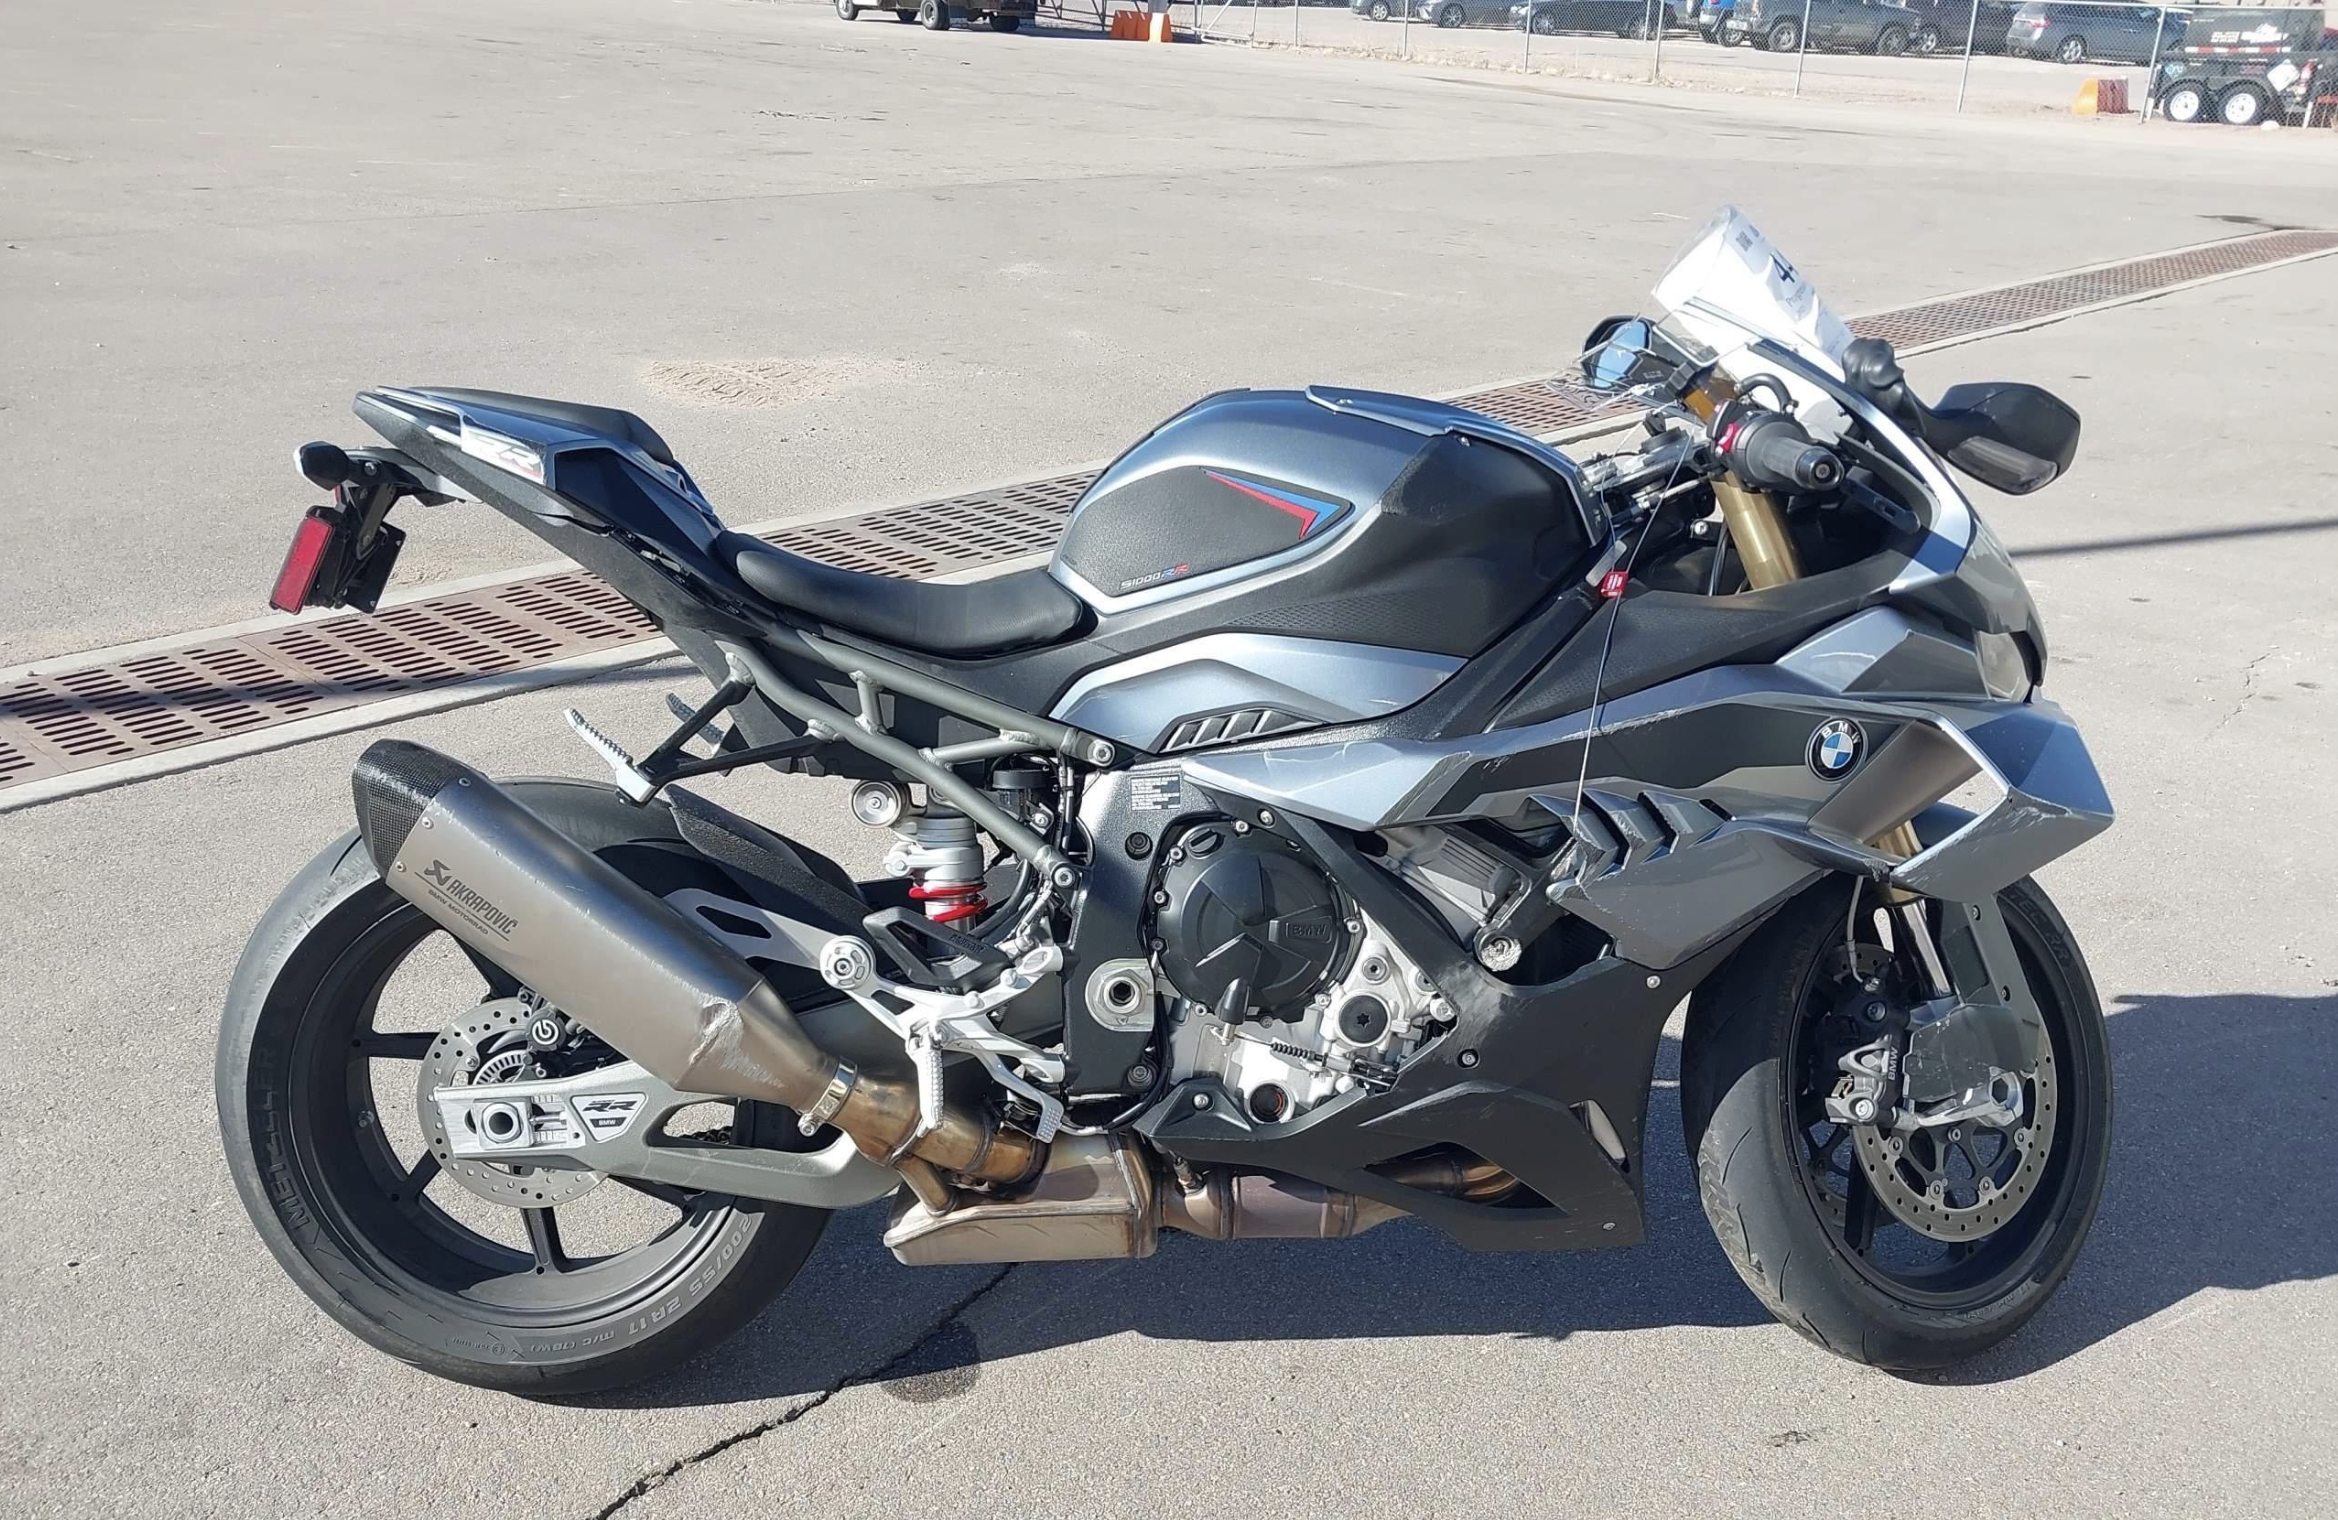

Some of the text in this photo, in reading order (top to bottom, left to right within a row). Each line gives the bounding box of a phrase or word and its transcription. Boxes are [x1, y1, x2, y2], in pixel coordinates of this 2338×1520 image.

[1121, 564, 1188, 588] S1000RR
[1821, 722, 1861, 744] BMW
[428, 888, 489, 935] BMW MOTORRAD
[1292, 924, 1327, 938] BMW
[1888, 1046, 1899, 1081] BMW
[254, 1047, 310, 1230] METZELER
[688, 1214, 753, 1298] 200/55
